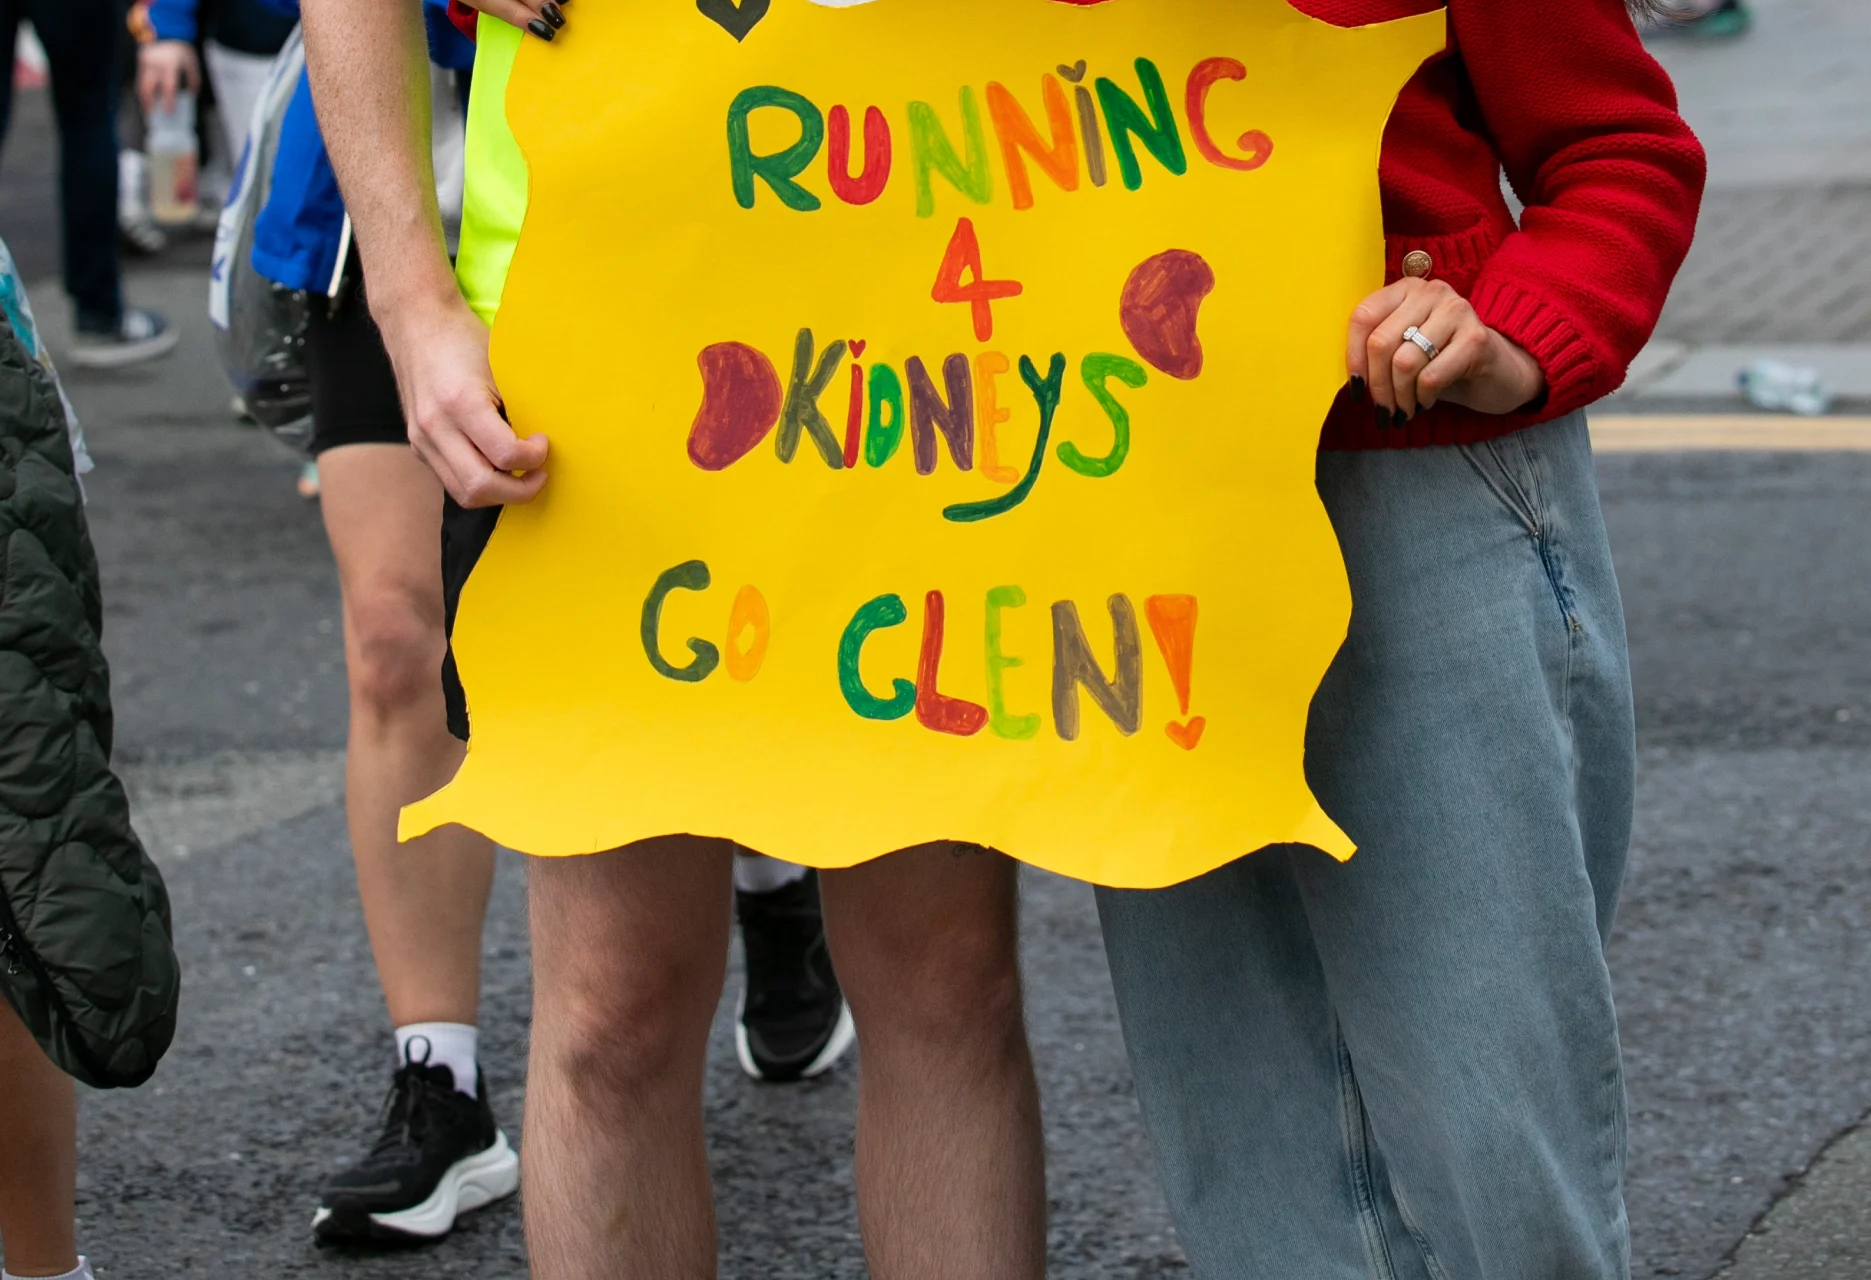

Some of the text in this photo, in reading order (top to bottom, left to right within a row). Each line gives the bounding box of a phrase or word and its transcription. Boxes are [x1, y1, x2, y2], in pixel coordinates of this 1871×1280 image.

[931, 217, 1023, 342] 4
[640, 559, 1207, 751] GO GLEN!
